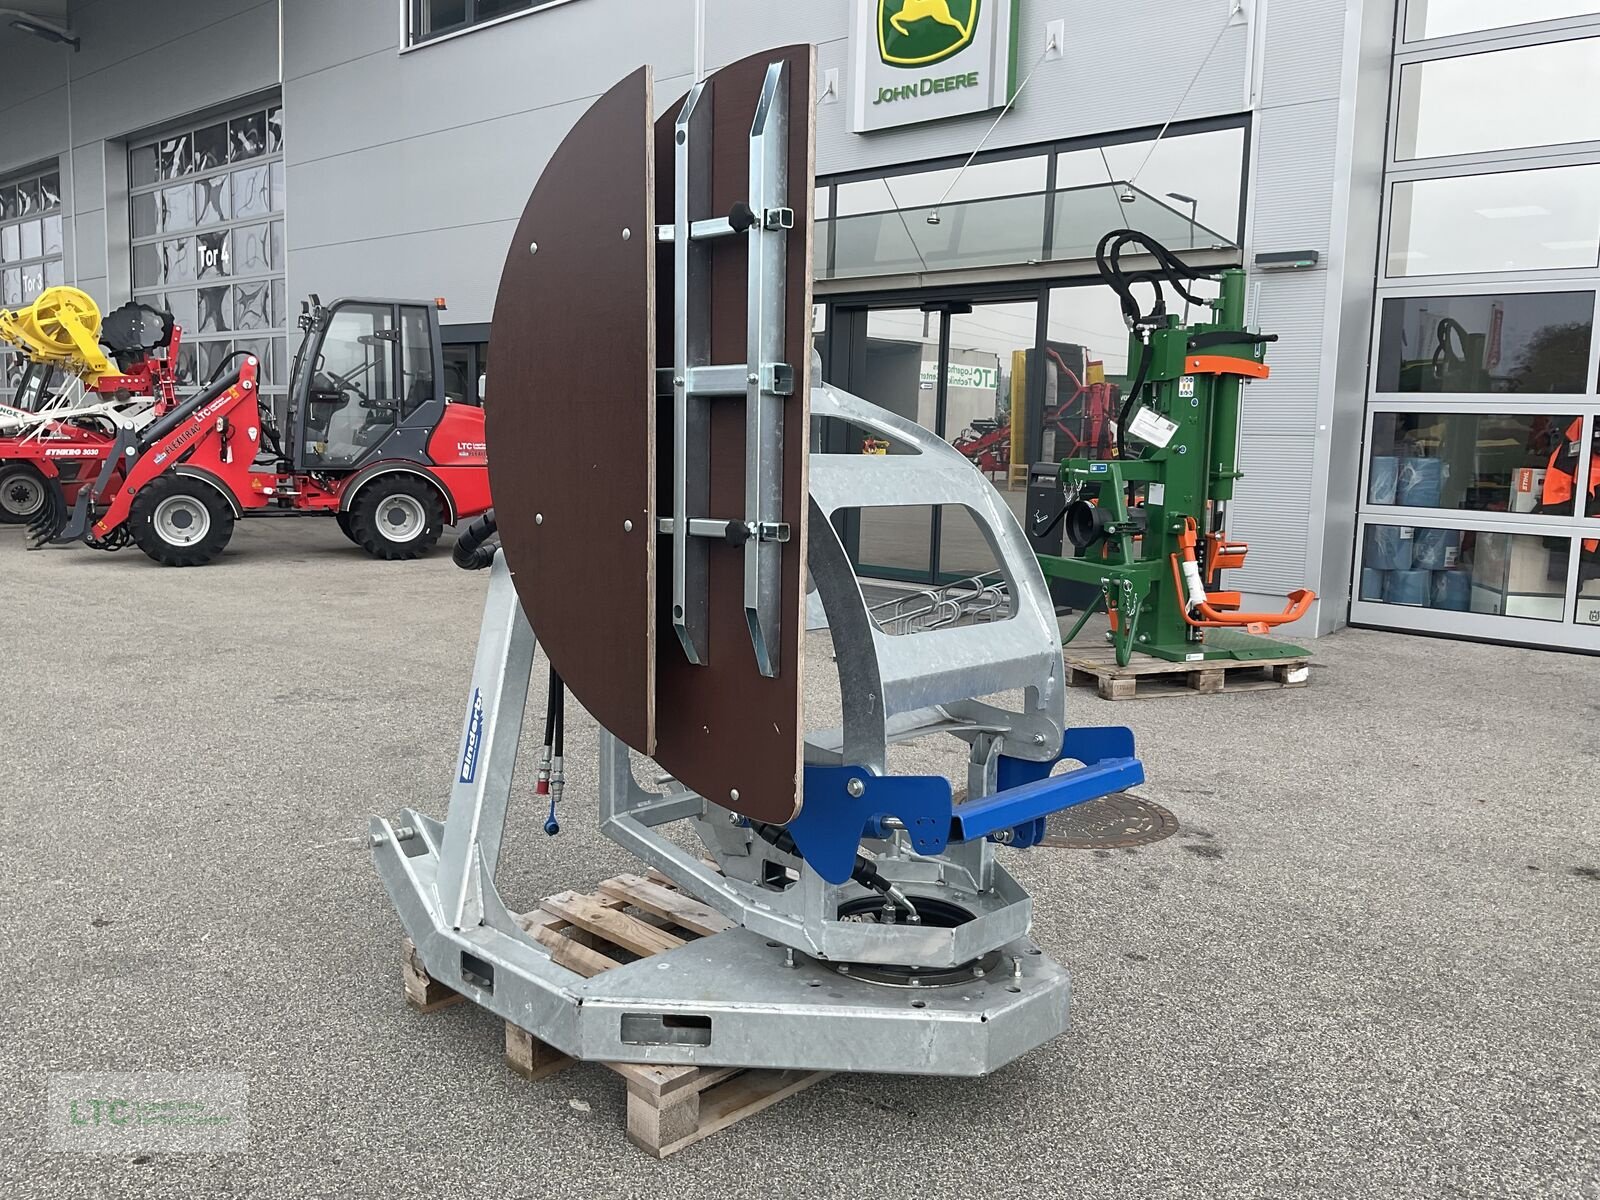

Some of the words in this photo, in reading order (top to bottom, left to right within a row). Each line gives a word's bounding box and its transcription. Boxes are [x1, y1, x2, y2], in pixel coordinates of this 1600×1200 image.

[872, 84, 918, 105] JOHN
[920, 71, 979, 97] DEERE
[198, 245, 219, 267] Tor
[221, 242, 230, 265] 4
[22, 274, 37, 293] Tor
[36, 273, 43, 290] 3
[194, 408, 211, 423] LTC
[164, 423, 201, 456] FLEXITRAC
[457, 442, 472, 450] LTC
[45, 448, 81, 456] SYNKRO
[82, 448, 99, 456] 3030
[1521, 471, 1530, 491] STIHL
